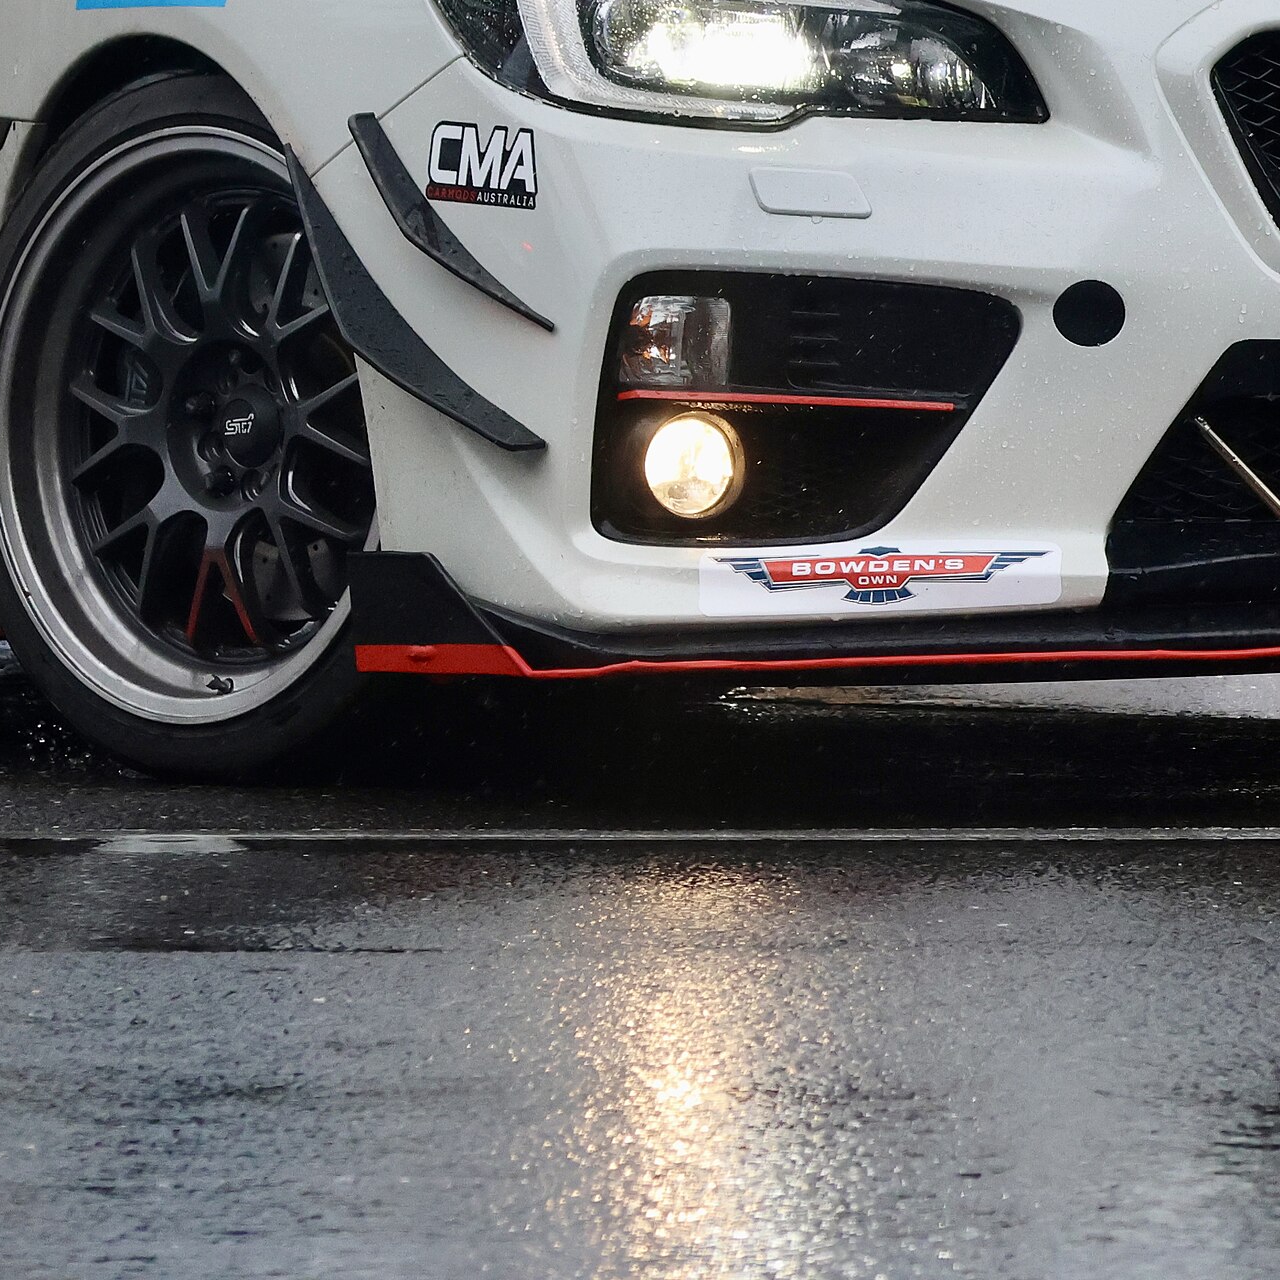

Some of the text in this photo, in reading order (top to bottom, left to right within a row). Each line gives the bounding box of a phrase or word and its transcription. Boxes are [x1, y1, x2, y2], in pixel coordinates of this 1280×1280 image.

[429, 124, 537, 194] CMA
[476, 191, 535, 208] AUSTRALIA
[791, 557, 964, 577] BOWDEN'S
[857, 574, 898, 586] OWN
